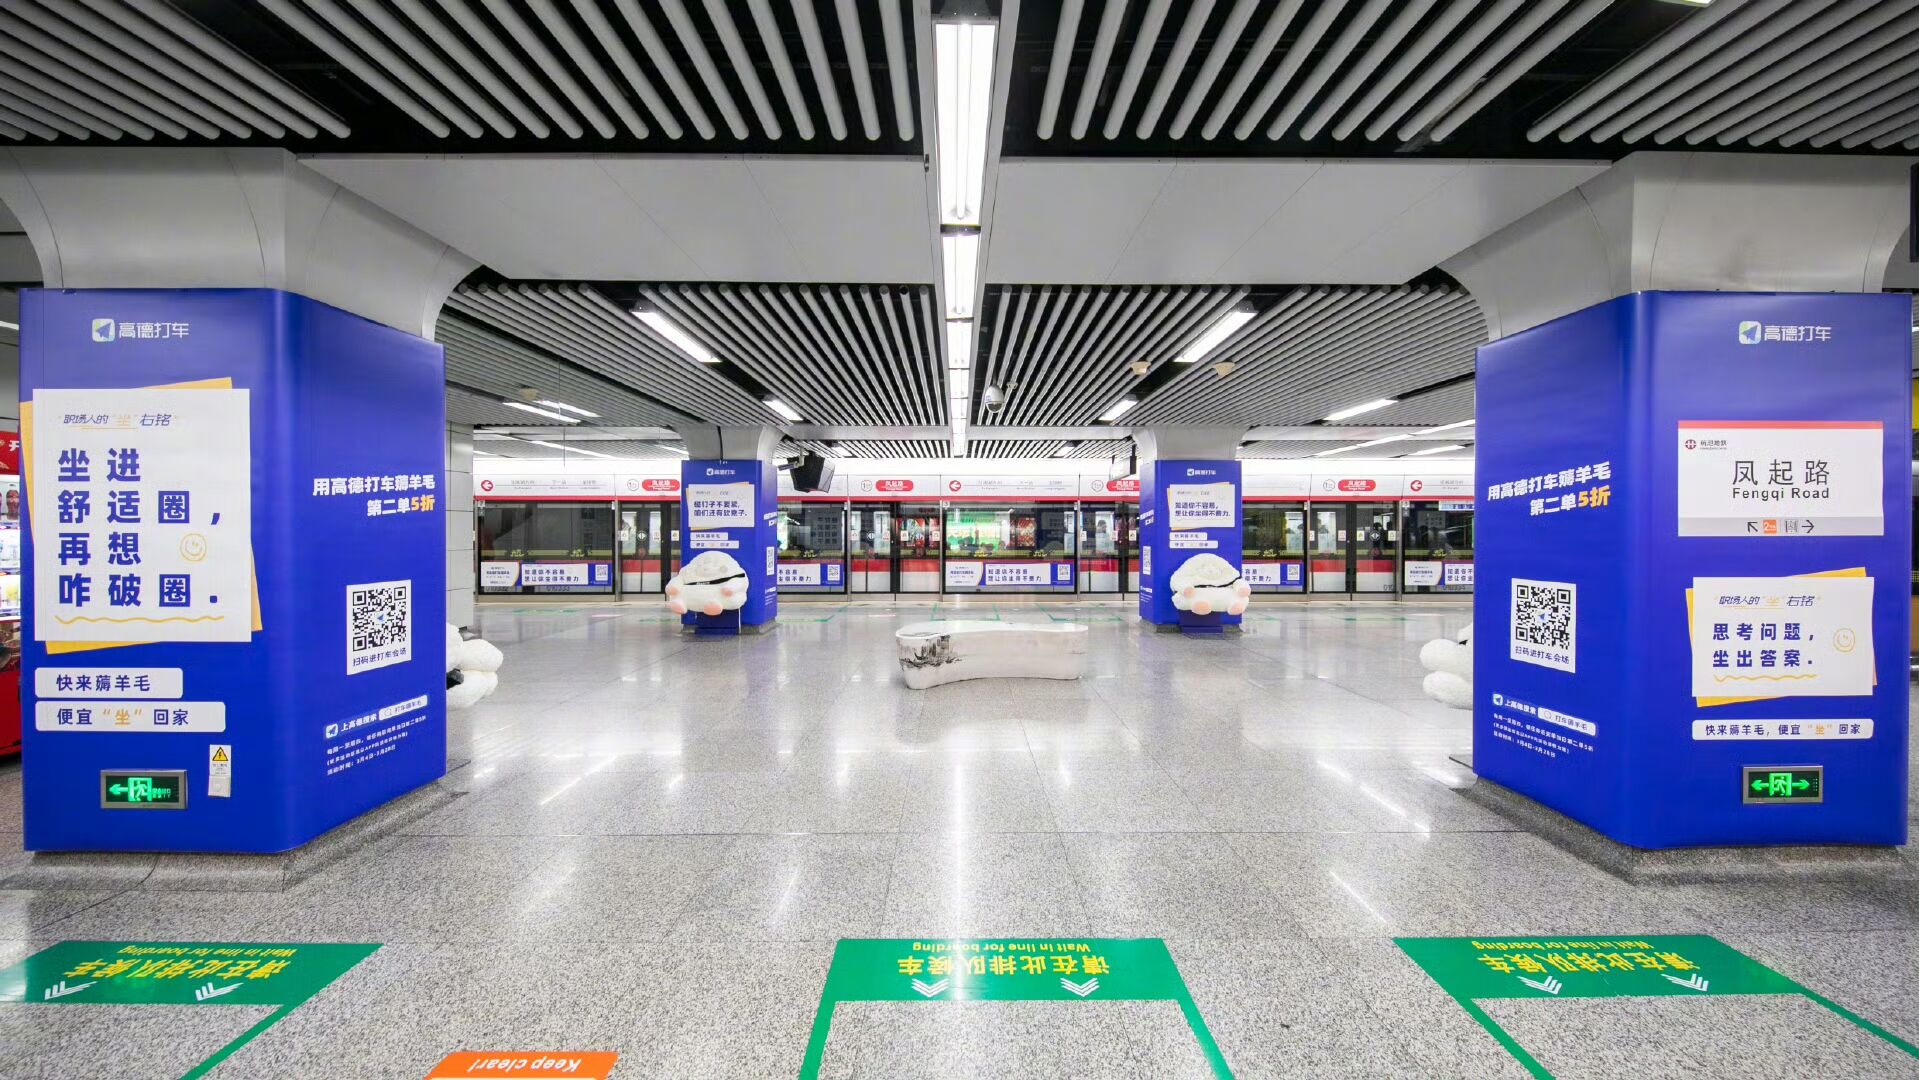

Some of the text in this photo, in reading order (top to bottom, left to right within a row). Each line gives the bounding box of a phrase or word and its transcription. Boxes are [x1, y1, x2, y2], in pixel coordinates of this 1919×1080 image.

[118, 321, 190, 339] 高德打车
[1763, 325, 1832, 342] 高德打车
[57, 447, 141, 483] 坐进
[1732, 458, 1830, 486] 凤起路
[1529, 484, 1611, 517] 第二单5折
[1732, 487, 1830, 502] Fengqi Road
[366, 494, 436, 517] 第二单5折
[57, 531, 142, 566] 再想
[56, 674, 151, 693] 快来薅羊毛
[984, 944, 1004, 953] for
[1009, 944, 1035, 953] line
[1039, 944, 1053, 953] in
[1056, 943, 1091, 953] Wait
[63, 958, 292, 981] 请在此排队候车
[897, 954, 1110, 976] 请在此排队候车
[1477, 951, 1701, 975] 请在此排队候车
[466, 1056, 582, 1073] Keep clear!
